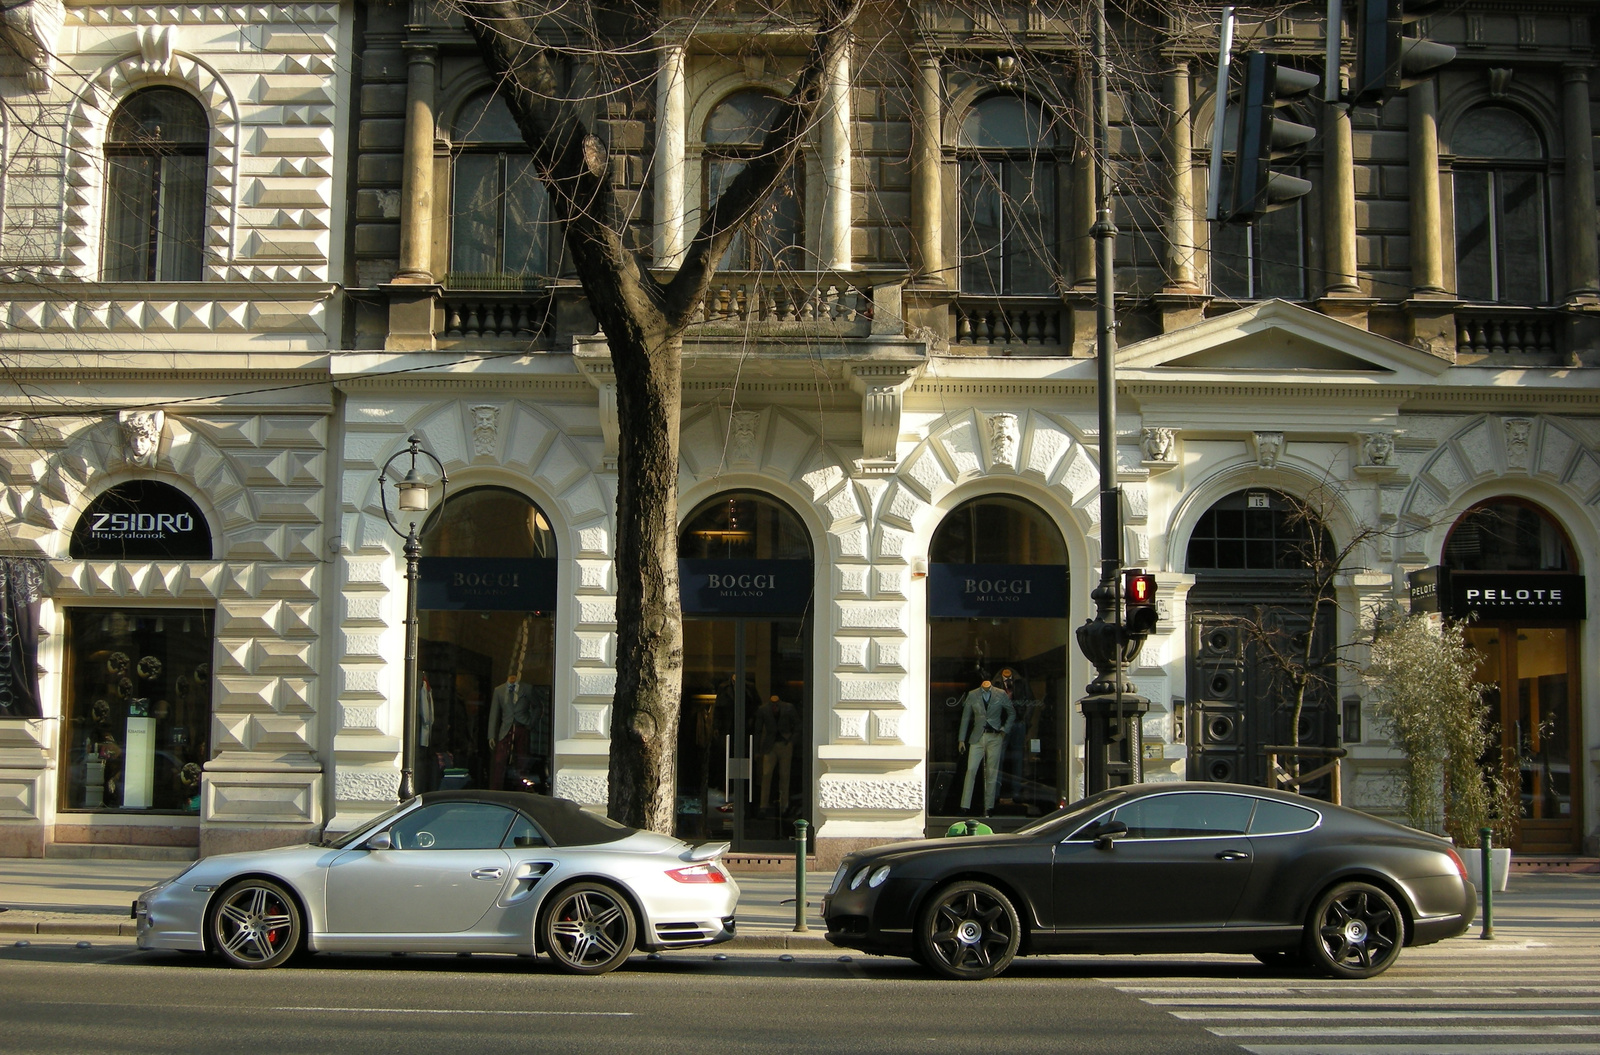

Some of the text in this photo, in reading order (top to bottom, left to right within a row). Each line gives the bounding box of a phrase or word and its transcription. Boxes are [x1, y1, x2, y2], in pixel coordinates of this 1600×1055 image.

[1255, 498, 1264, 507] 15
[92, 512, 193, 533] ZSIDRÓ
[92, 532, 166, 540] Hajszalonok
[708, 574, 776, 589] BOGGI
[965, 579, 1032, 594] BOGGI
[1411, 582, 1436, 597] PELOTE
[1466, 589, 1562, 600] PELOTE
